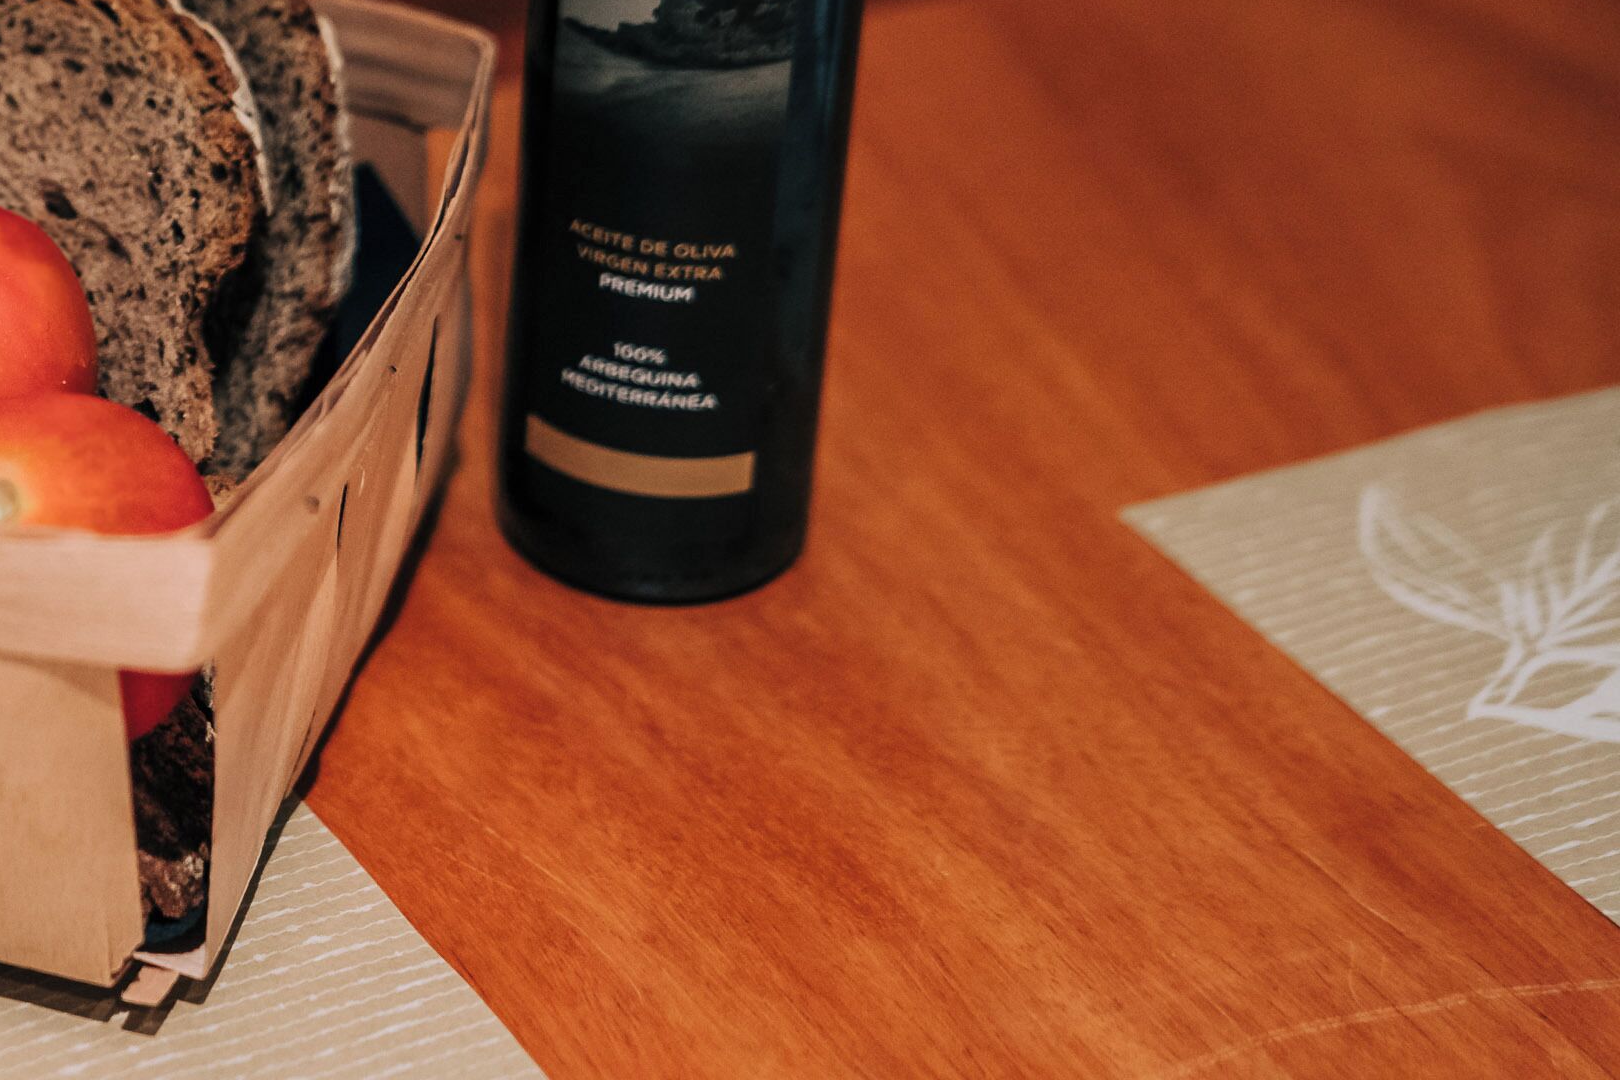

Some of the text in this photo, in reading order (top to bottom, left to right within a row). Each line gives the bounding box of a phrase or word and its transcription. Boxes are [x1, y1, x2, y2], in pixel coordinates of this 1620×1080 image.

[570, 219, 736, 258] ACEITE DE OLIVA
[578, 246, 723, 280] VIRGEN EXTRA
[599, 272, 694, 301] PREMIUM
[614, 341, 665, 364] 100%
[580, 355, 699, 388] ARBEQUINA
